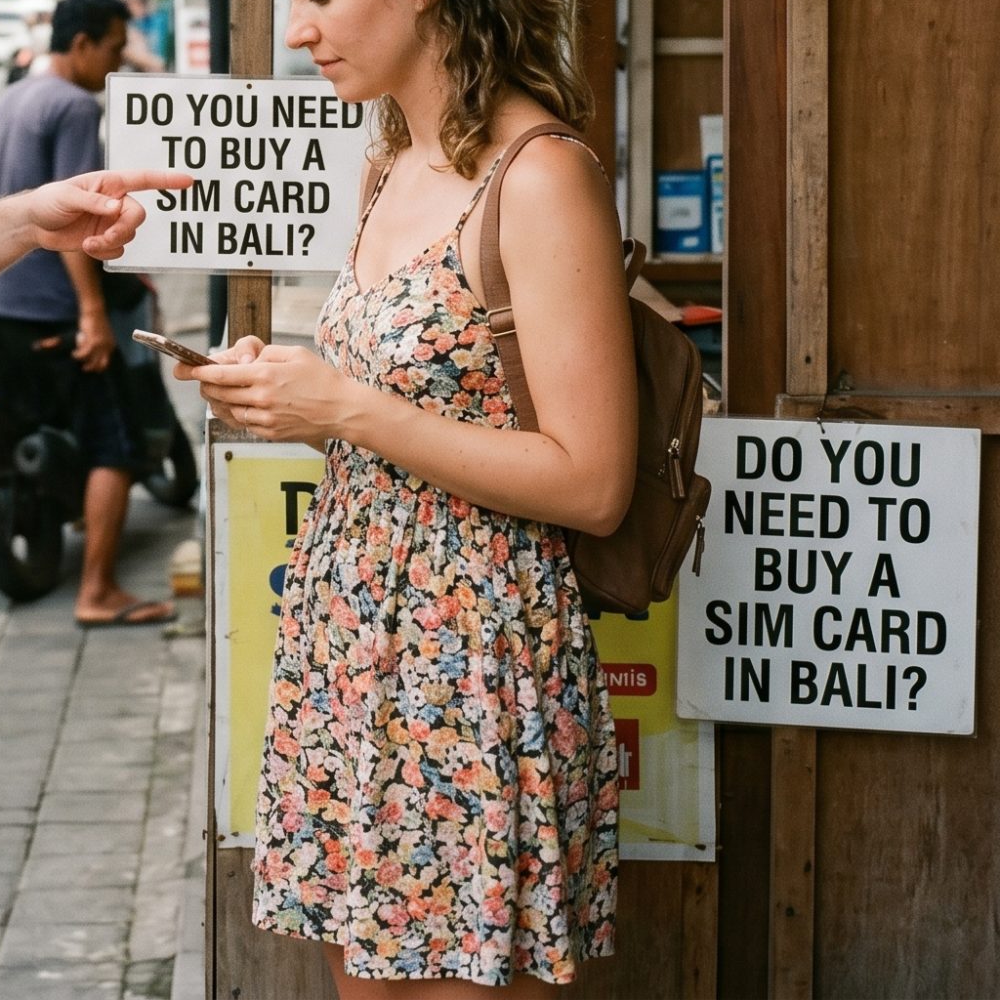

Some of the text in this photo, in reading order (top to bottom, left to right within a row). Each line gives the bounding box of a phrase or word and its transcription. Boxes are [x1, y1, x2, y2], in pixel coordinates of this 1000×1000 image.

[126, 92, 364, 129] DO YOU NEED
[161, 135, 326, 171] TO BUY A
[156, 179, 330, 214] SIM CARD
[169, 221, 316, 256] IN BALI?
[736, 435, 921, 487] DO YOU
[724, 489, 931, 544] NEED TO
[754, 547, 901, 599] BUY A
[704, 599, 947, 656] SIM CARD
[724, 656, 928, 711] IN BALI?
